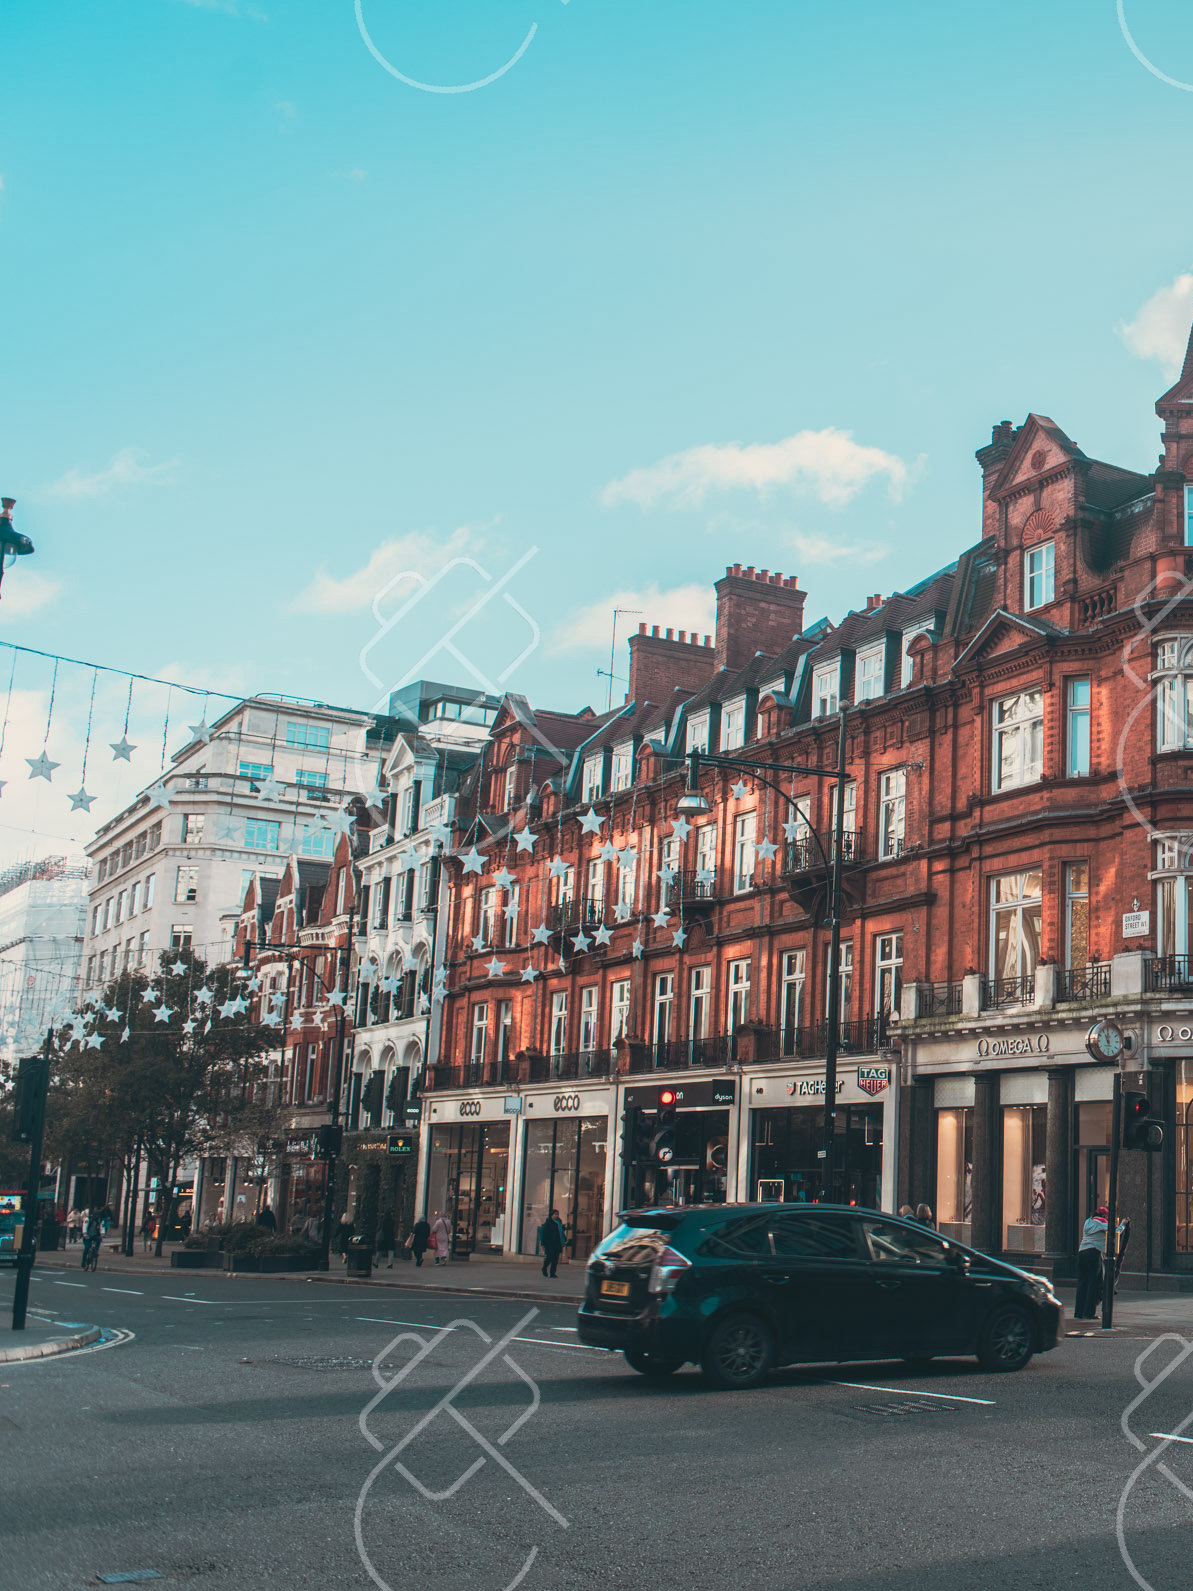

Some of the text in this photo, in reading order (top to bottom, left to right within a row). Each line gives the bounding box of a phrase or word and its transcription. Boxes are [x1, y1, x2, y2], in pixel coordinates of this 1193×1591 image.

[1125, 914, 1141, 922] OXFORD
[1125, 921, 1140, 930] STREET
[992, 1037, 1033, 1055] OMEGA
[861, 1068, 886, 1078] TAG
[796, 1080, 844, 1095] TAGHer
[860, 1079, 887, 1094] HEUER
[554, 1095, 580, 1111] ecco
[714, 1094, 733, 1102] dyson
[460, 1101, 481, 1116] ecco
